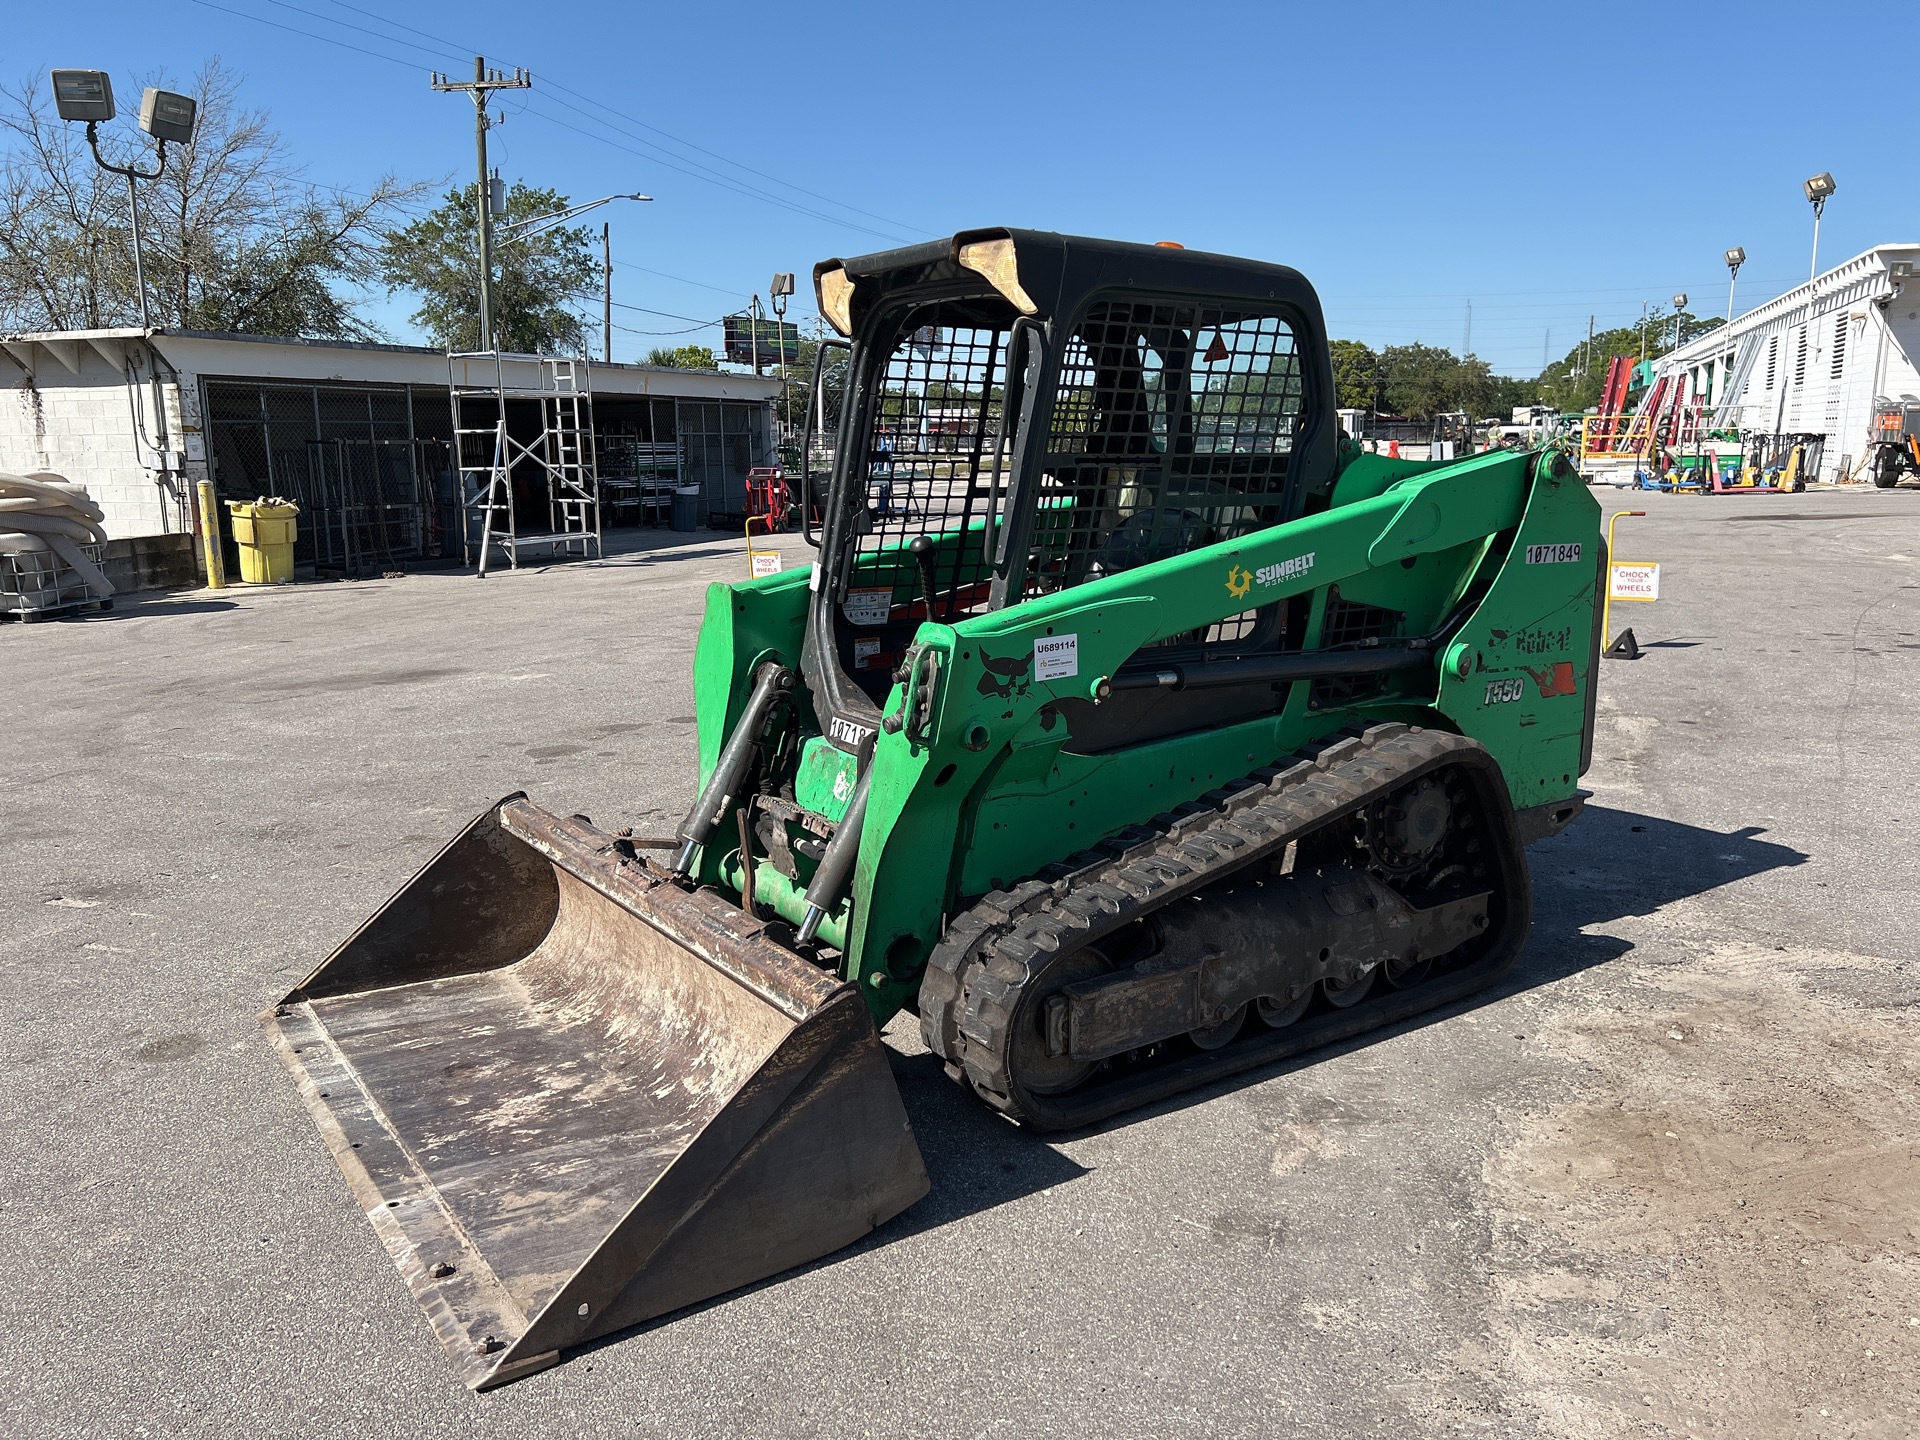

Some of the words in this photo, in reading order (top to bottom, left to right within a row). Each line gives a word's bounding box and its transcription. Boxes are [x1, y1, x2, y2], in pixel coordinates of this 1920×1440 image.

[1527, 544, 1580, 563] 1071849
[1255, 552, 1315, 584] SUNBELT
[1619, 570, 1650, 578] CHOCK
[1264, 568, 1308, 588] RENTALS
[1616, 584, 1652, 592] WHEELS
[1037, 640, 1075, 653] U689114
[1484, 677, 1524, 705] T550
